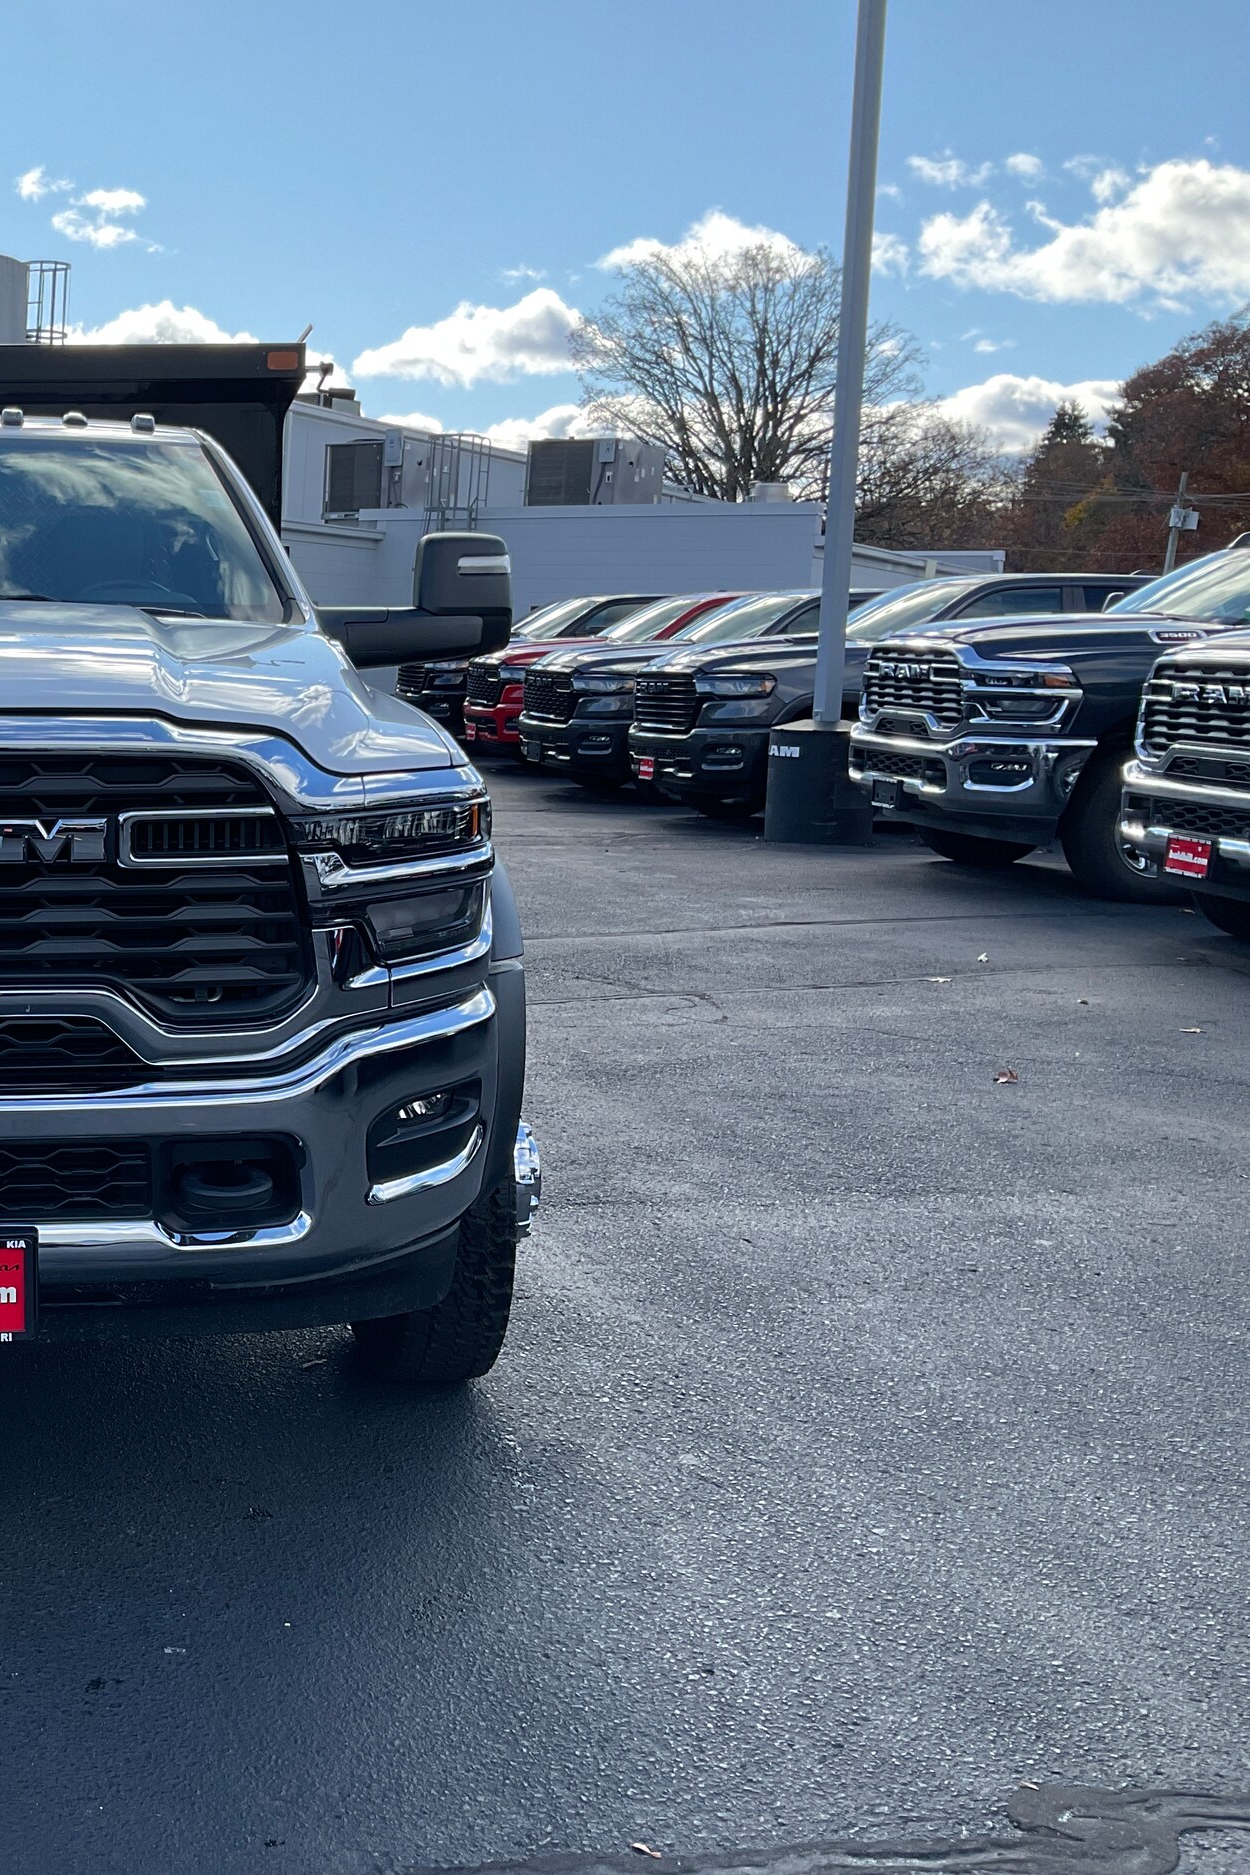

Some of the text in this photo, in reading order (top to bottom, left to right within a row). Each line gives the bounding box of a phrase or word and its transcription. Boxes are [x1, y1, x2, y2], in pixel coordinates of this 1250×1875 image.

[879, 662, 930, 679] RAM
[769, 745, 800, 758] AM
[6, 1240, 26, 1249] KIA
[1, 1333, 13, 1343] RI
